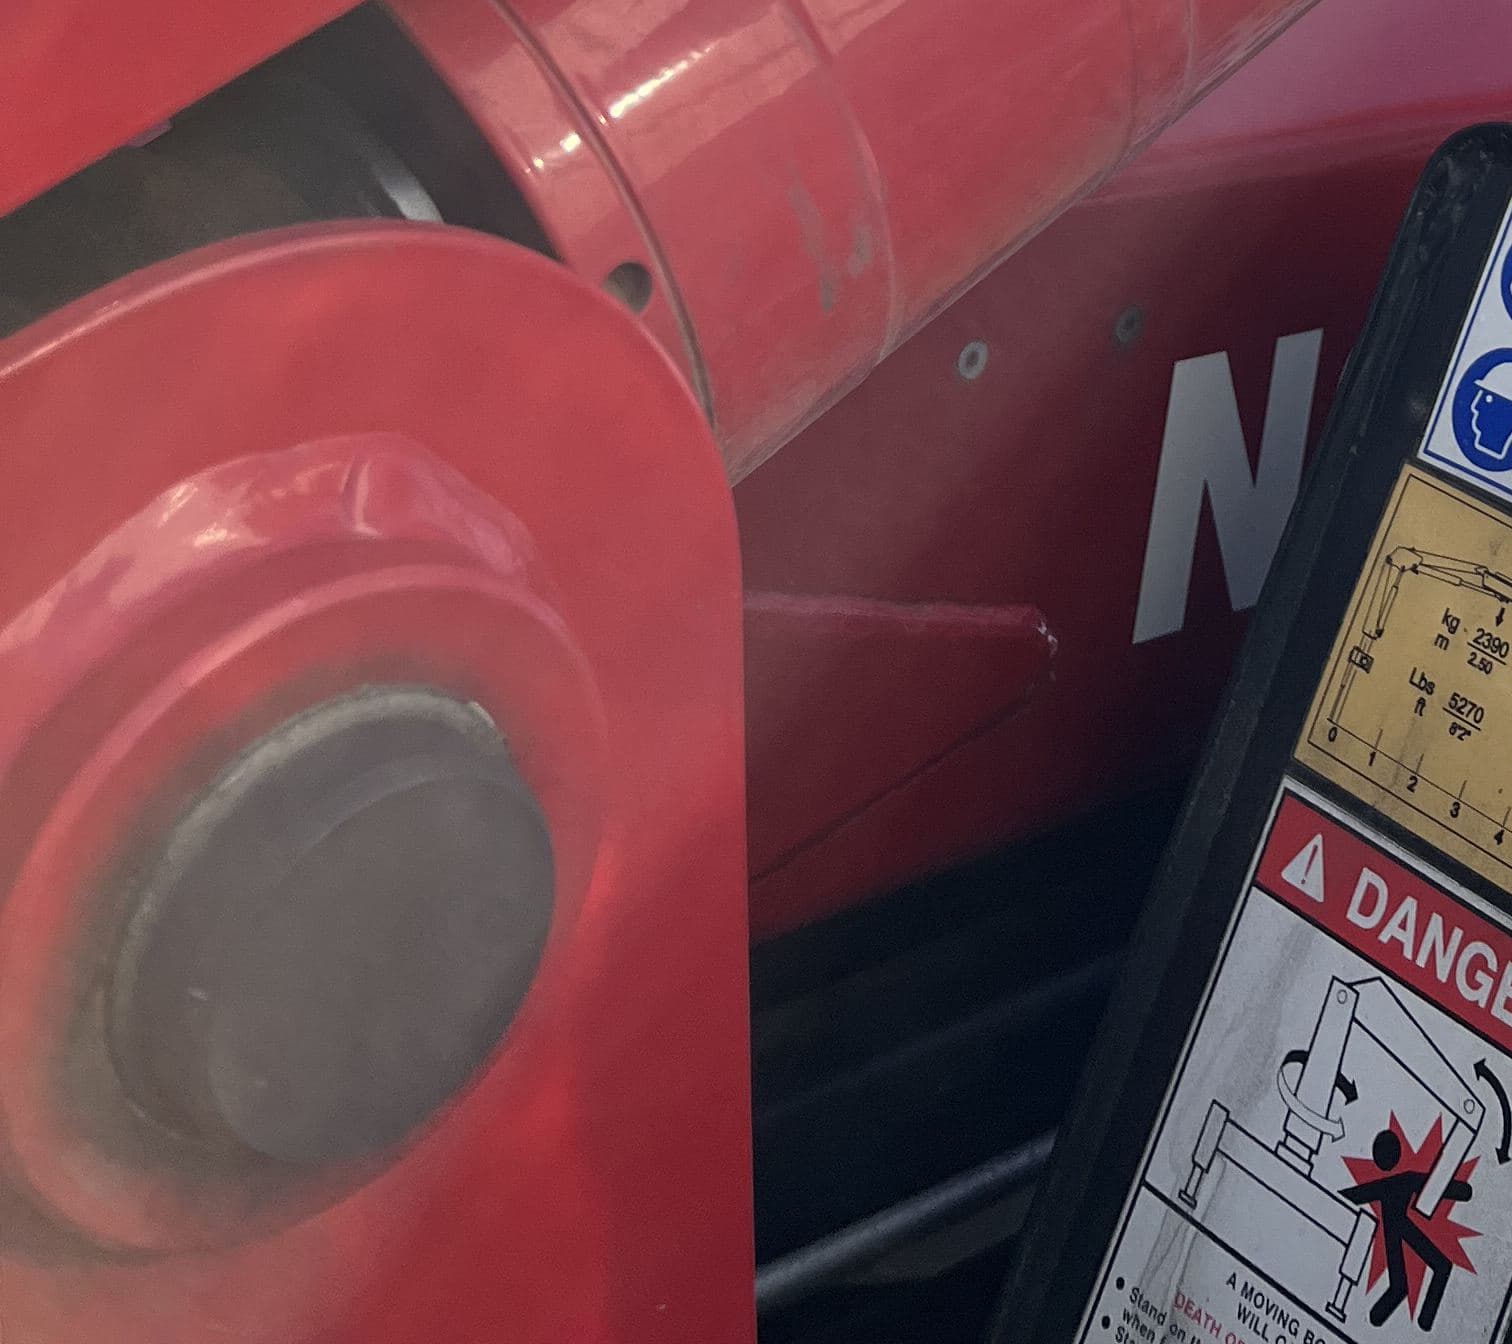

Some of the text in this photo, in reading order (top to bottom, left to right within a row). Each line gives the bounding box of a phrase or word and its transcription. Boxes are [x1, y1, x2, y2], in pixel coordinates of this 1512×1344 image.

[1433, 632, 1450, 651] m
[1466, 652, 1494, 675] 2.50
[1441, 607, 1461, 635] kg
[1472, 628, 1510, 659] 2390
[1409, 667, 1436, 695] Lbs
[1447, 692, 1485, 724] 5270
[1414, 698, 1428, 716] ft
[1327, 726, 1338, 742] 0
[1368, 751, 1377, 766] 1
[1406, 776, 1418, 793] 2
[1449, 801, 1461, 818] 3
[1493, 828, 1505, 845] 4
[1122, 1307, 1156, 1344] when
[1129, 1286, 1168, 1326] Stand
[1169, 1323, 1186, 1344] on
[1174, 1291, 1222, 1339] DEATH
[1225, 1272, 1237, 1291] A
[1240, 1281, 1300, 1339] MOVING
[1237, 1302, 1269, 1344] WILL
